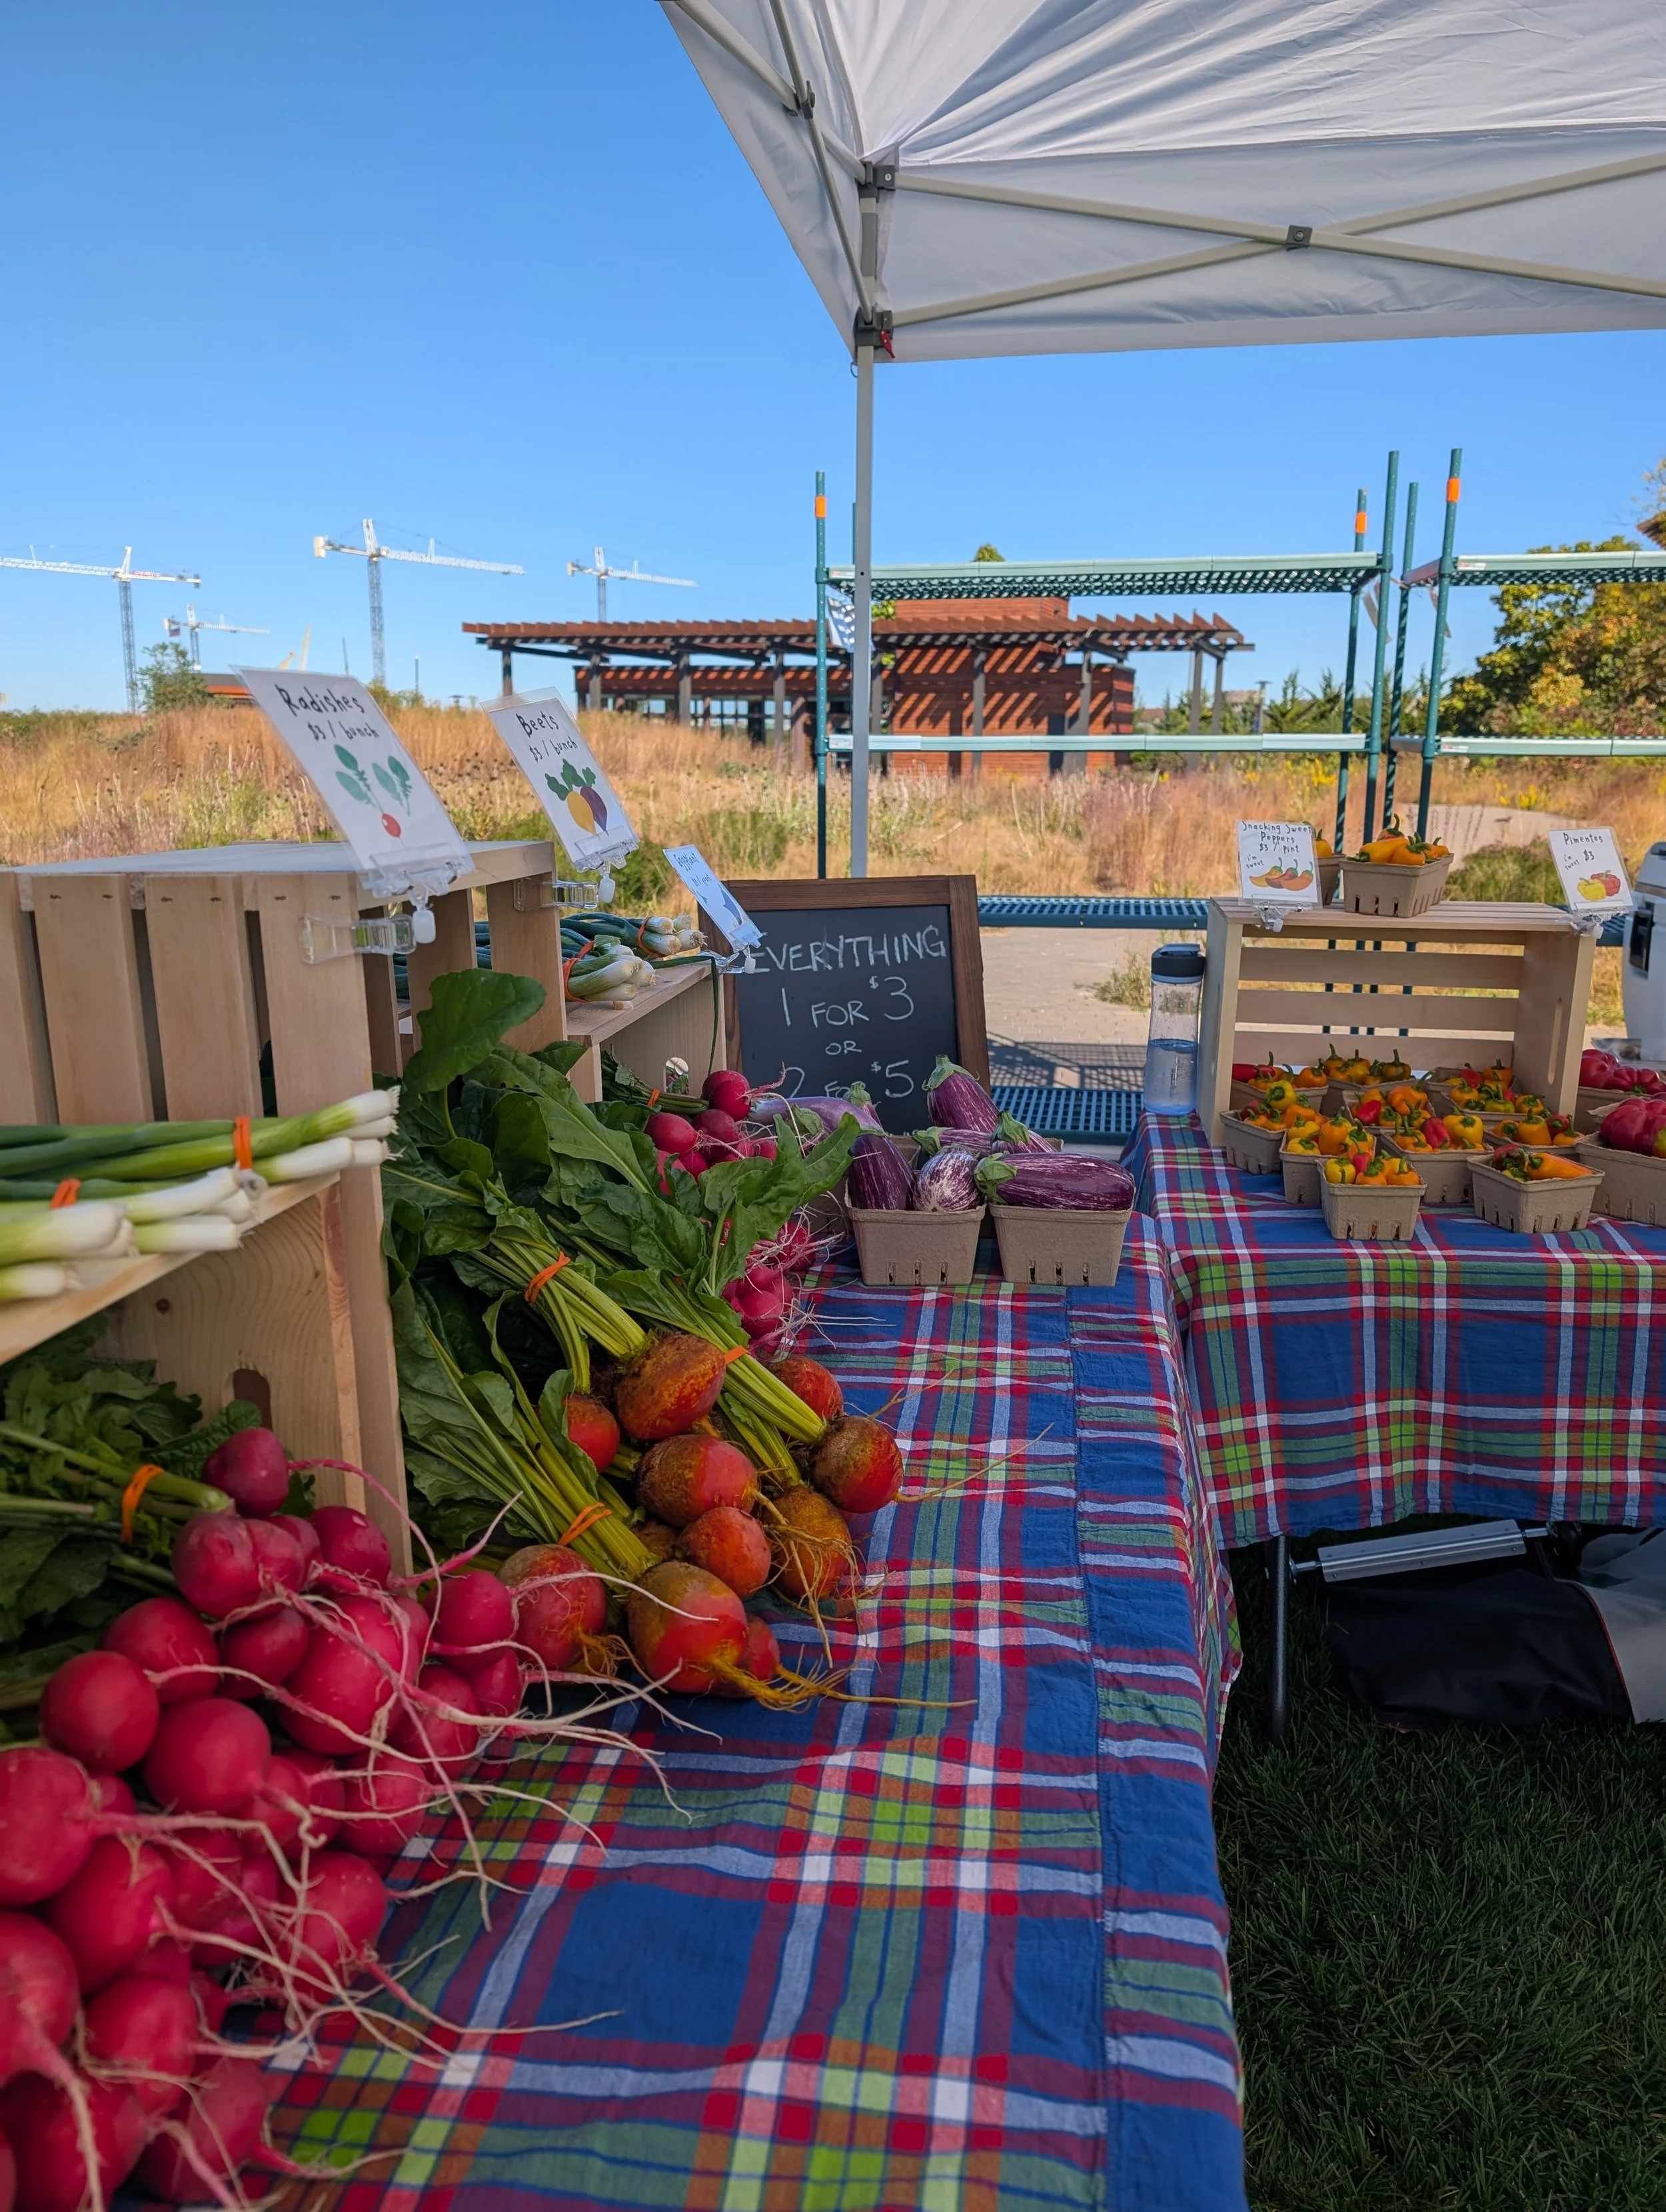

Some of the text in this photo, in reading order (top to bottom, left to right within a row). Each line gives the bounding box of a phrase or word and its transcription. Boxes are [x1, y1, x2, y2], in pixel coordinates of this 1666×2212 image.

[275, 683, 365, 717] Radishes
[307, 720, 379, 742] $3 / bunch
[515, 710, 559, 739] Beets
[528, 735, 578, 763] $3 / bunch
[1242, 820, 1311, 834] Snacking Sweet
[1260, 830, 1295, 844] Peppers
[1563, 831, 1603, 845] Pimentos
[1259, 841, 1299, 855] $3 / pint
[1583, 849, 1595, 861] $3
[673, 851, 700, 871] Eggplant
[1246, 859, 1264, 868] sweet
[1564, 859, 1581, 870] sweet
[781, 987, 792, 1027] 1
[811, 1000, 870, 1028] FOR
[825, 1040, 862, 1055] OR
[824, 1080, 866, 1098] FO
